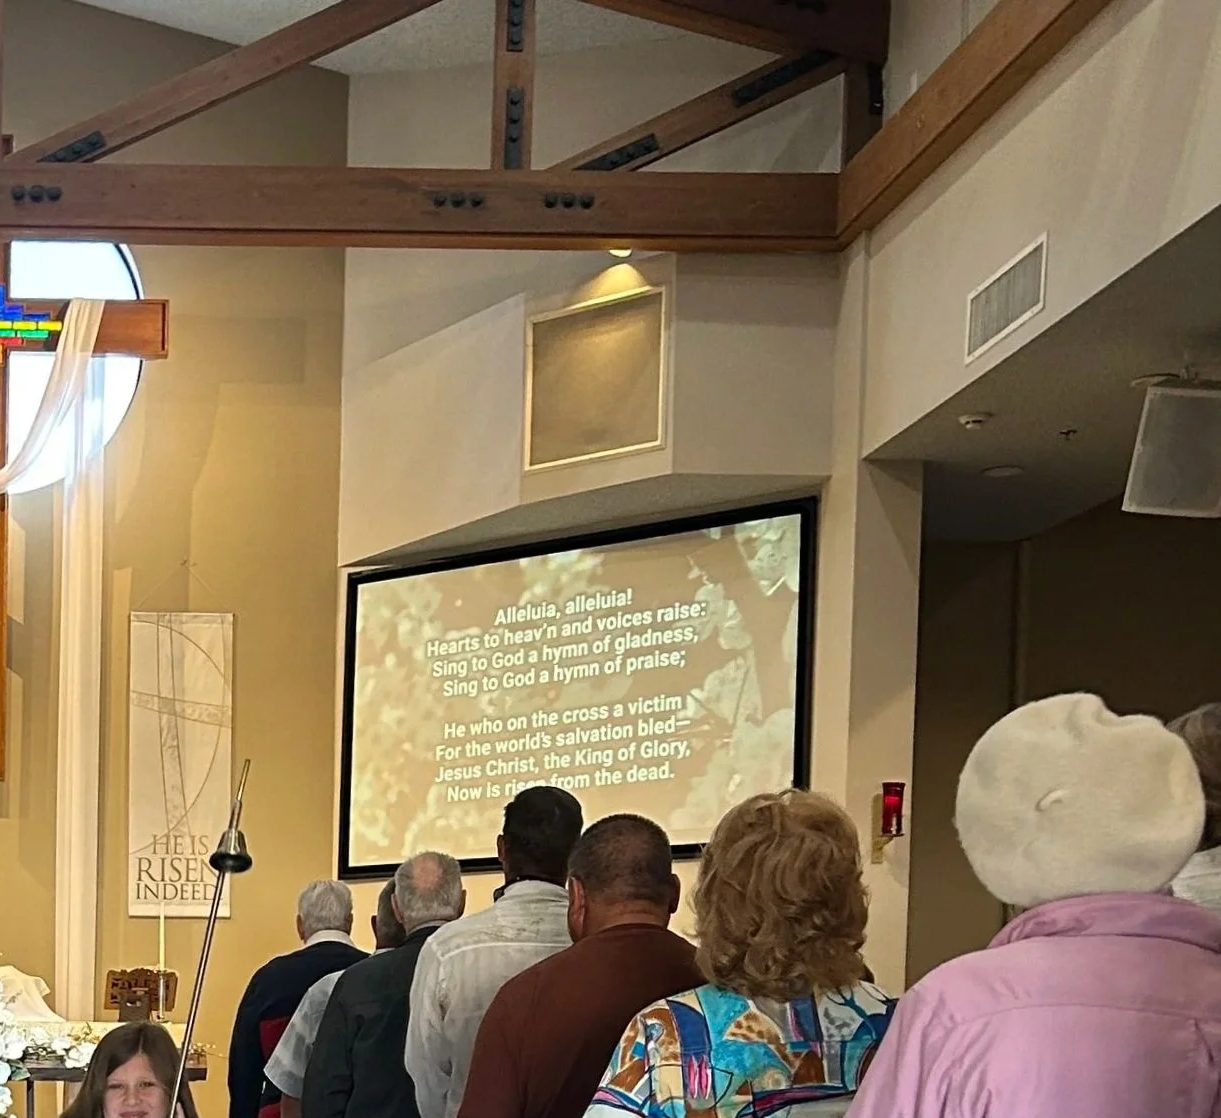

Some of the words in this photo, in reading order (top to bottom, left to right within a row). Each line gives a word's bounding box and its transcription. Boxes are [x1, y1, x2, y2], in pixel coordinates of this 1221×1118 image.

[494, 602, 561, 626] Alleluia,
[565, 588, 633, 615] alleluia!
[427, 636, 480, 657] Hearts
[484, 633, 499, 648] to
[561, 615, 592, 637] and
[596, 611, 652, 631] voices
[657, 602, 707, 623] raise:
[432, 660, 468, 678] Sing
[471, 656, 487, 671] to
[492, 648, 524, 669] God
[528, 650, 538, 663] a
[542, 642, 588, 664] hymn
[592, 634, 612, 654] of
[614, 626, 698, 655] gladness,
[443, 679, 478, 697] Sing
[482, 676, 498, 691] to
[502, 667, 536, 688] God
[539, 670, 549, 683] a
[553, 662, 600, 684] hymn
[604, 655, 623, 674] of
[626, 650, 686, 676] praise;
[444, 723, 466, 739] He
[470, 717, 503, 736] who
[507, 715, 528, 731] on
[531, 710, 558, 728] the
[562, 705, 609, 724] cross
[613, 703, 624, 717] a
[627, 694, 682, 715] victim
[435, 745, 462, 761] For
[465, 740, 491, 758] the
[556, 723, 633, 747] salvation
[435, 764, 482, 783] Jesus
[485, 756, 539, 776] Christ,
[543, 752, 571, 770] the
[575, 748, 613, 767] King
[618, 742, 637, 761] of
[640, 740, 691, 760] Glory,
[447, 785, 483, 802] Now
[486, 782, 501, 798] is
[550, 774, 590, 789] from
[594, 768, 622, 786] the
[626, 761, 675, 783] dead.
[152, 834, 184, 855] HE
[190, 835, 209, 855] IS
